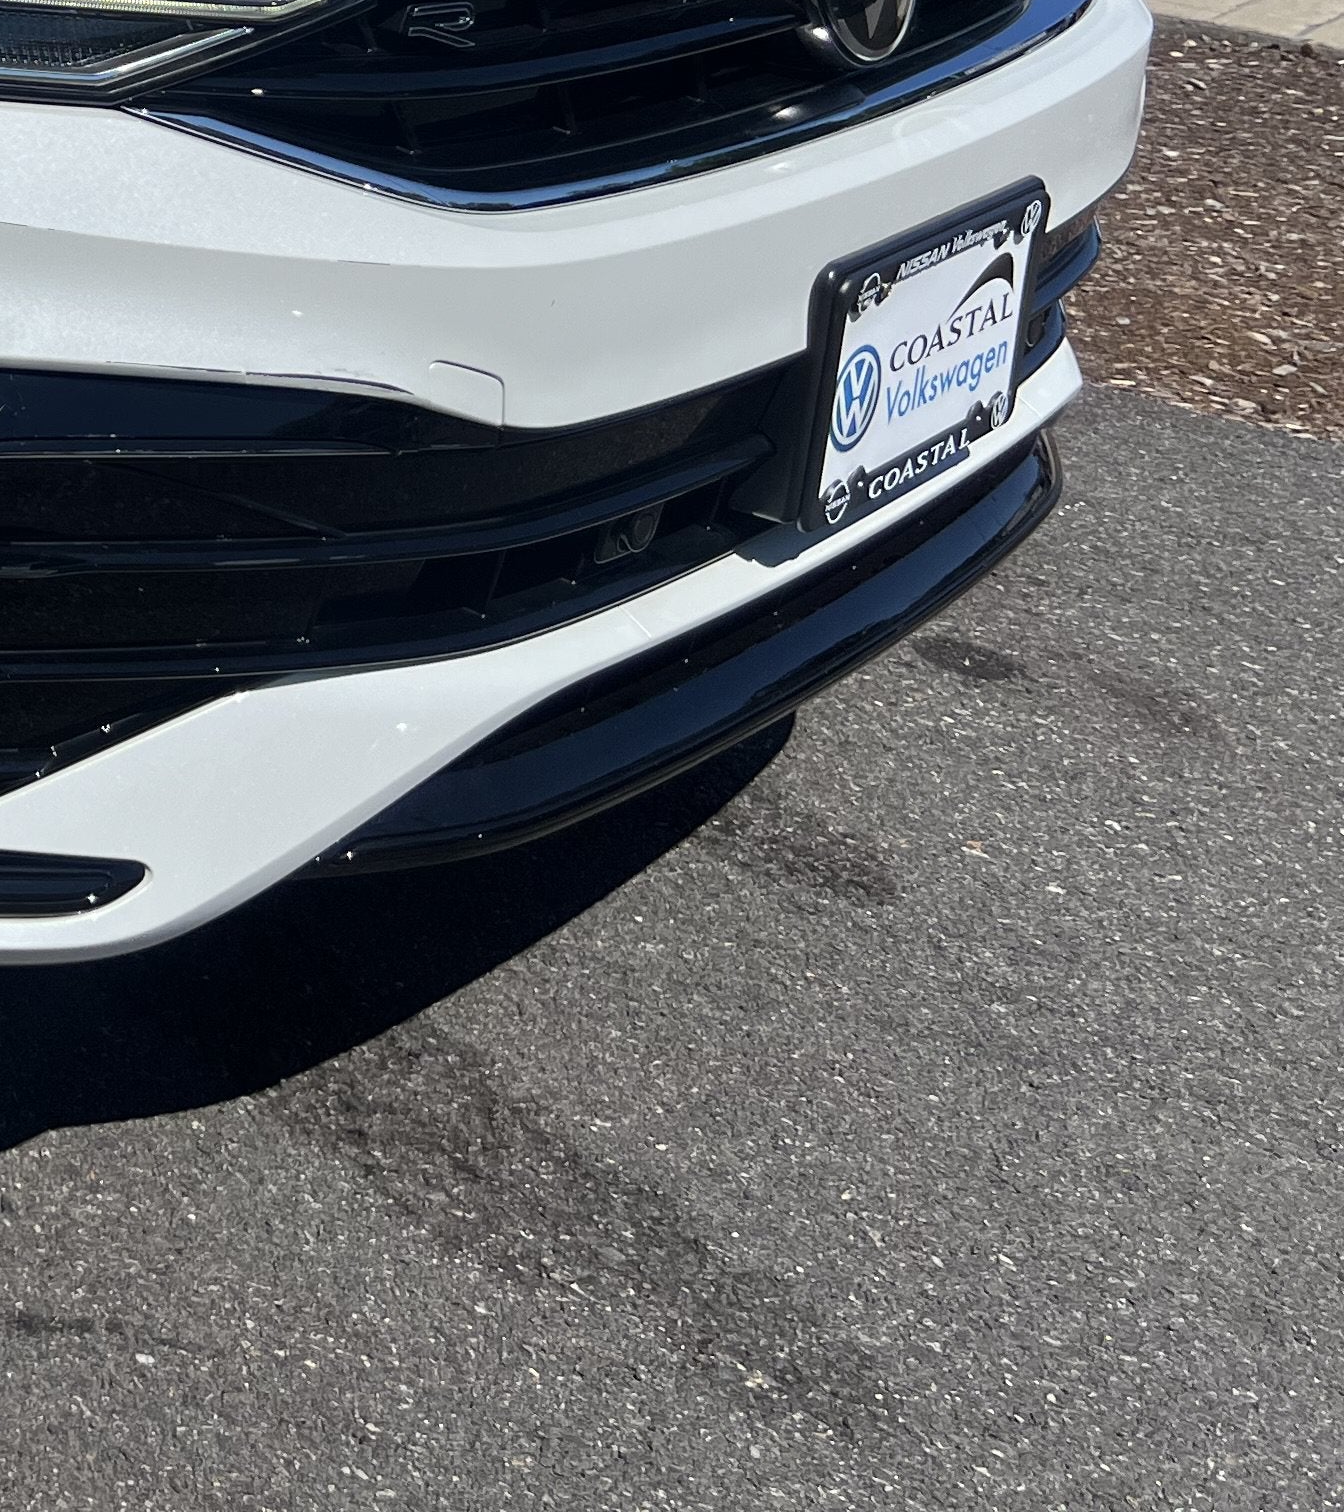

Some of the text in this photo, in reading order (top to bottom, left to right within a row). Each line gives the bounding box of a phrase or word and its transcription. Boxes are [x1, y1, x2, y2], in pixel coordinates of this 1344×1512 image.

[896, 242, 951, 281] NISSAN
[889, 291, 1014, 372] COASTAL
[885, 340, 1008, 425] Volkswagen
[868, 428, 971, 499] COASTAL
